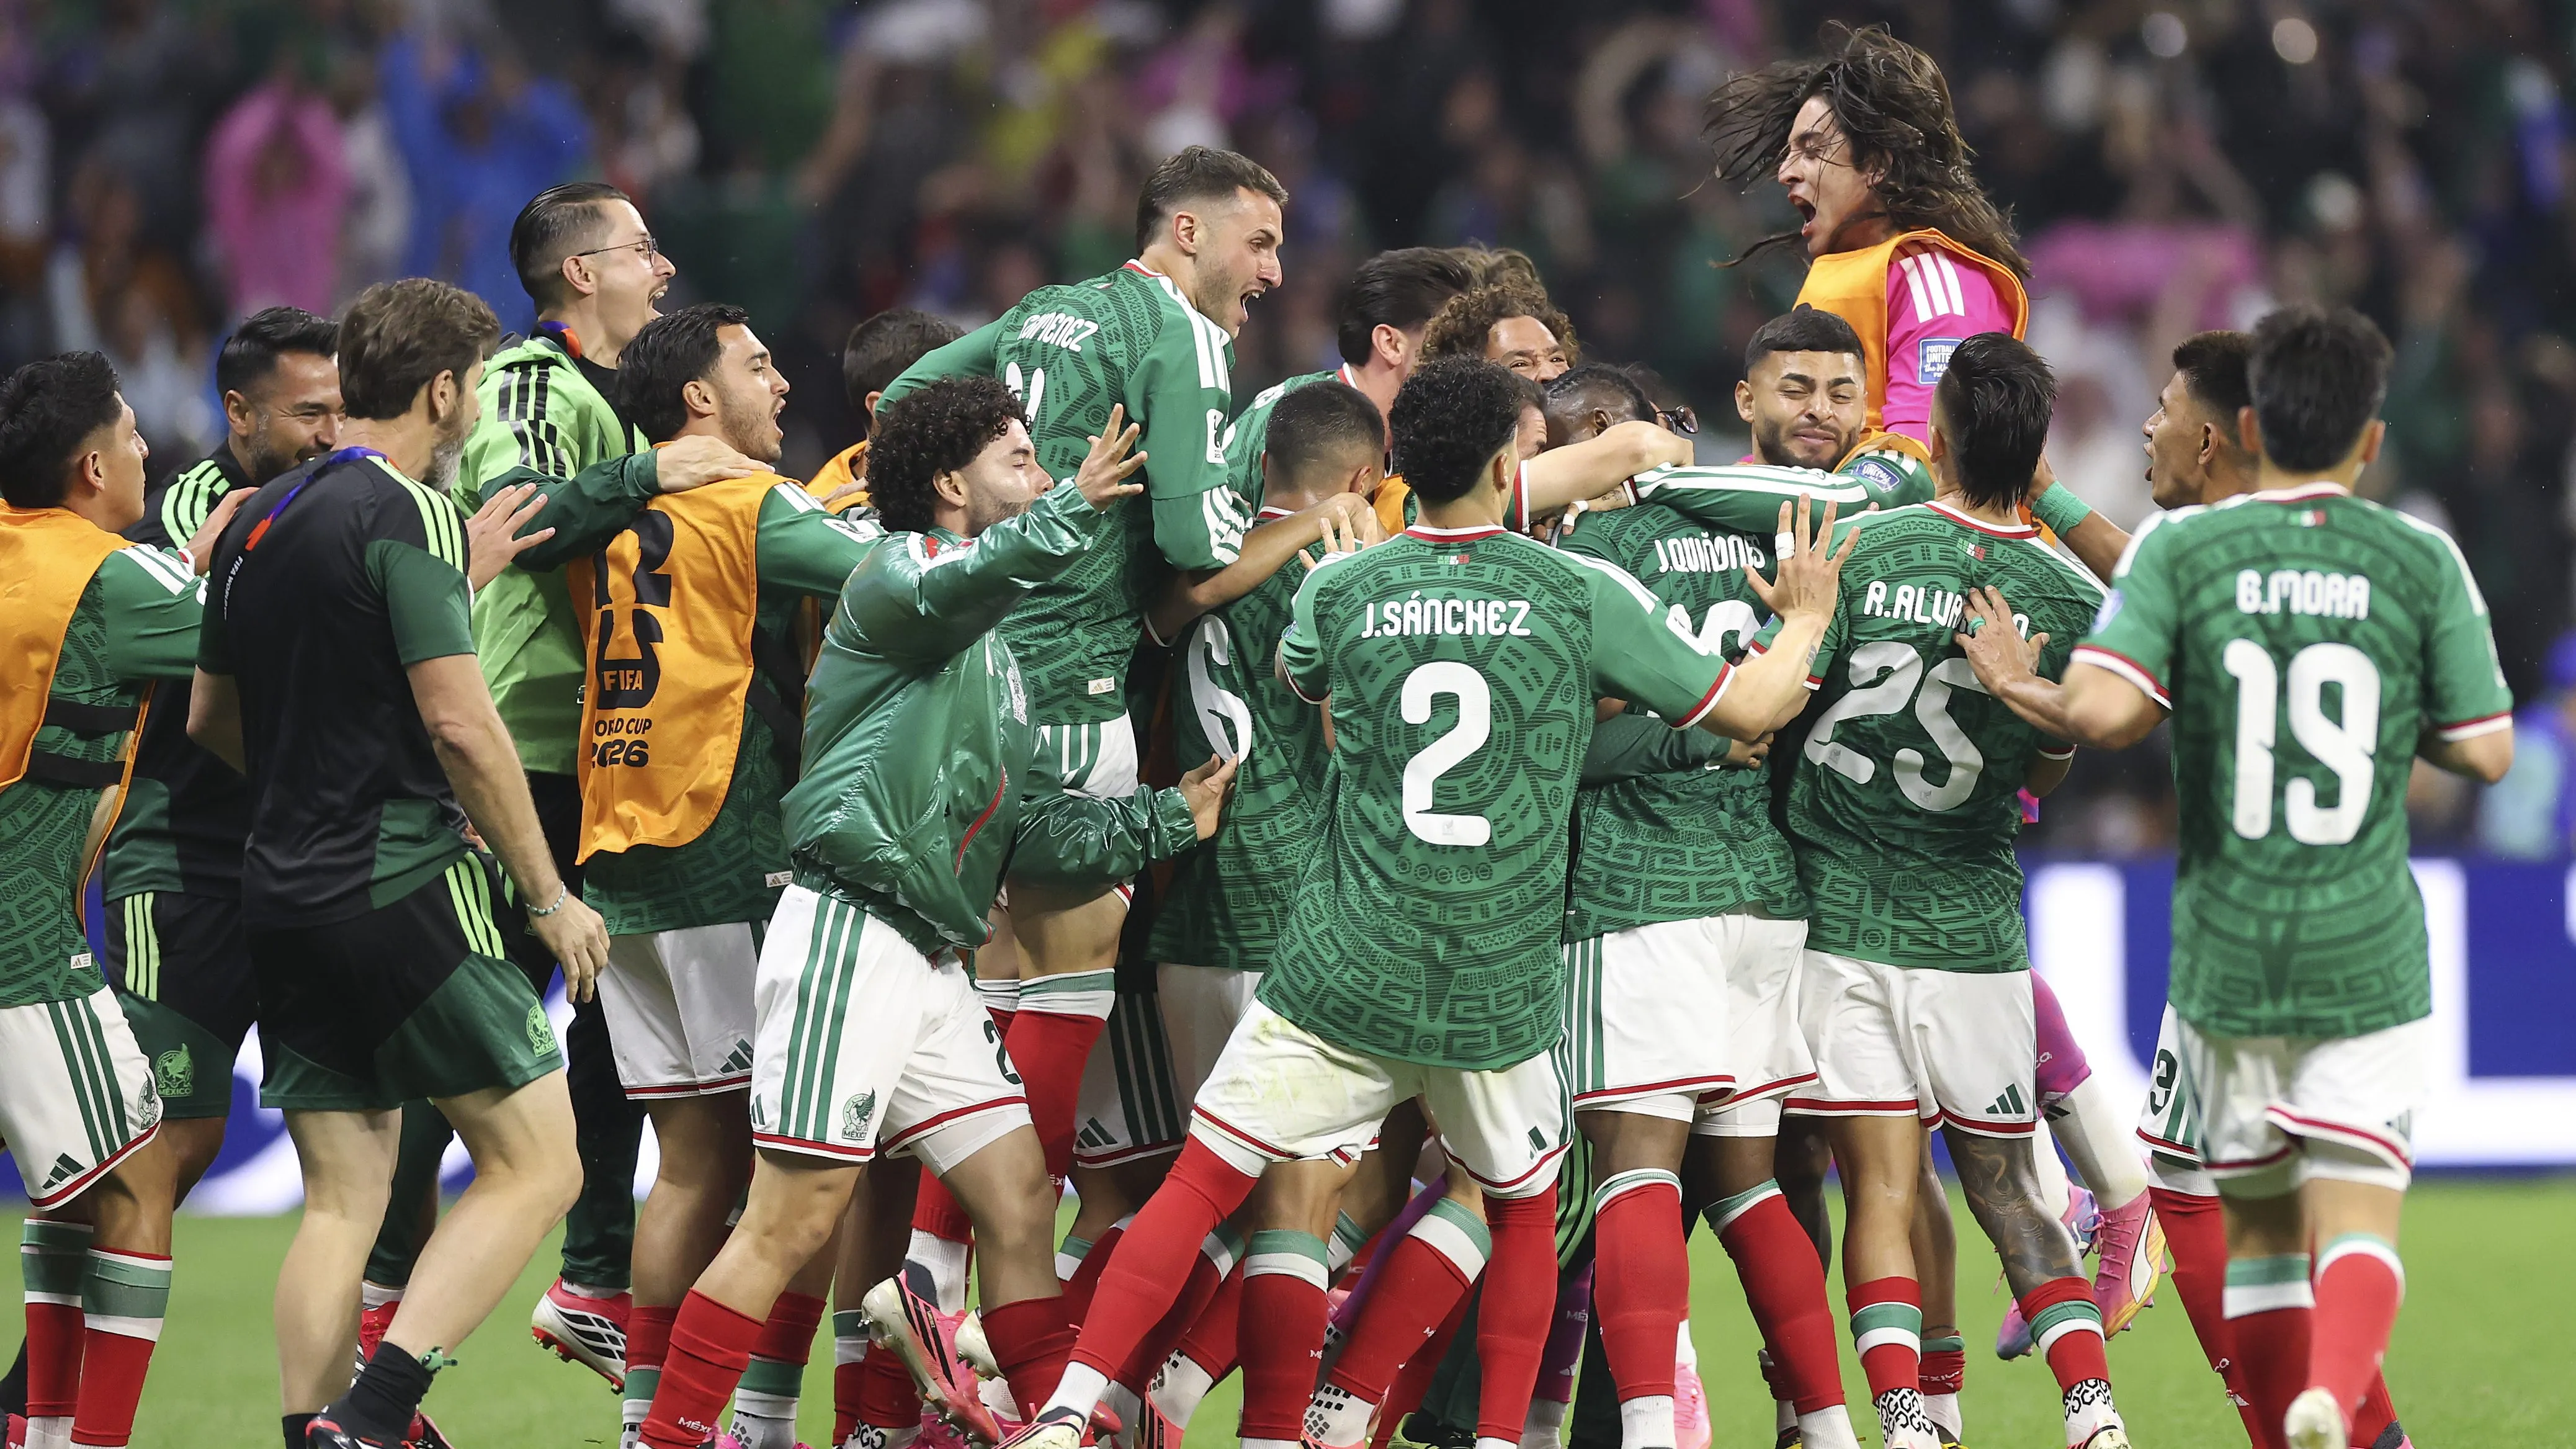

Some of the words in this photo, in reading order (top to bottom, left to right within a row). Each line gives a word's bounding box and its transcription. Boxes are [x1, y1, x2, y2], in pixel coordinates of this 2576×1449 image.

[1926, 353, 1951, 363] UNITE
[230, 555, 243, 576] FIFA
[2235, 569, 2371, 621] G.MORA
[1361, 590, 1531, 638] J.SÁNCHEZ
[604, 670, 643, 690] FIFA
[626, 718, 652, 735] CUP
[1804, 641, 1983, 811] 25
[2223, 637, 2381, 845] 19
[1400, 662, 1491, 846] 2
[678, 1416, 712, 1433] MÉXI
